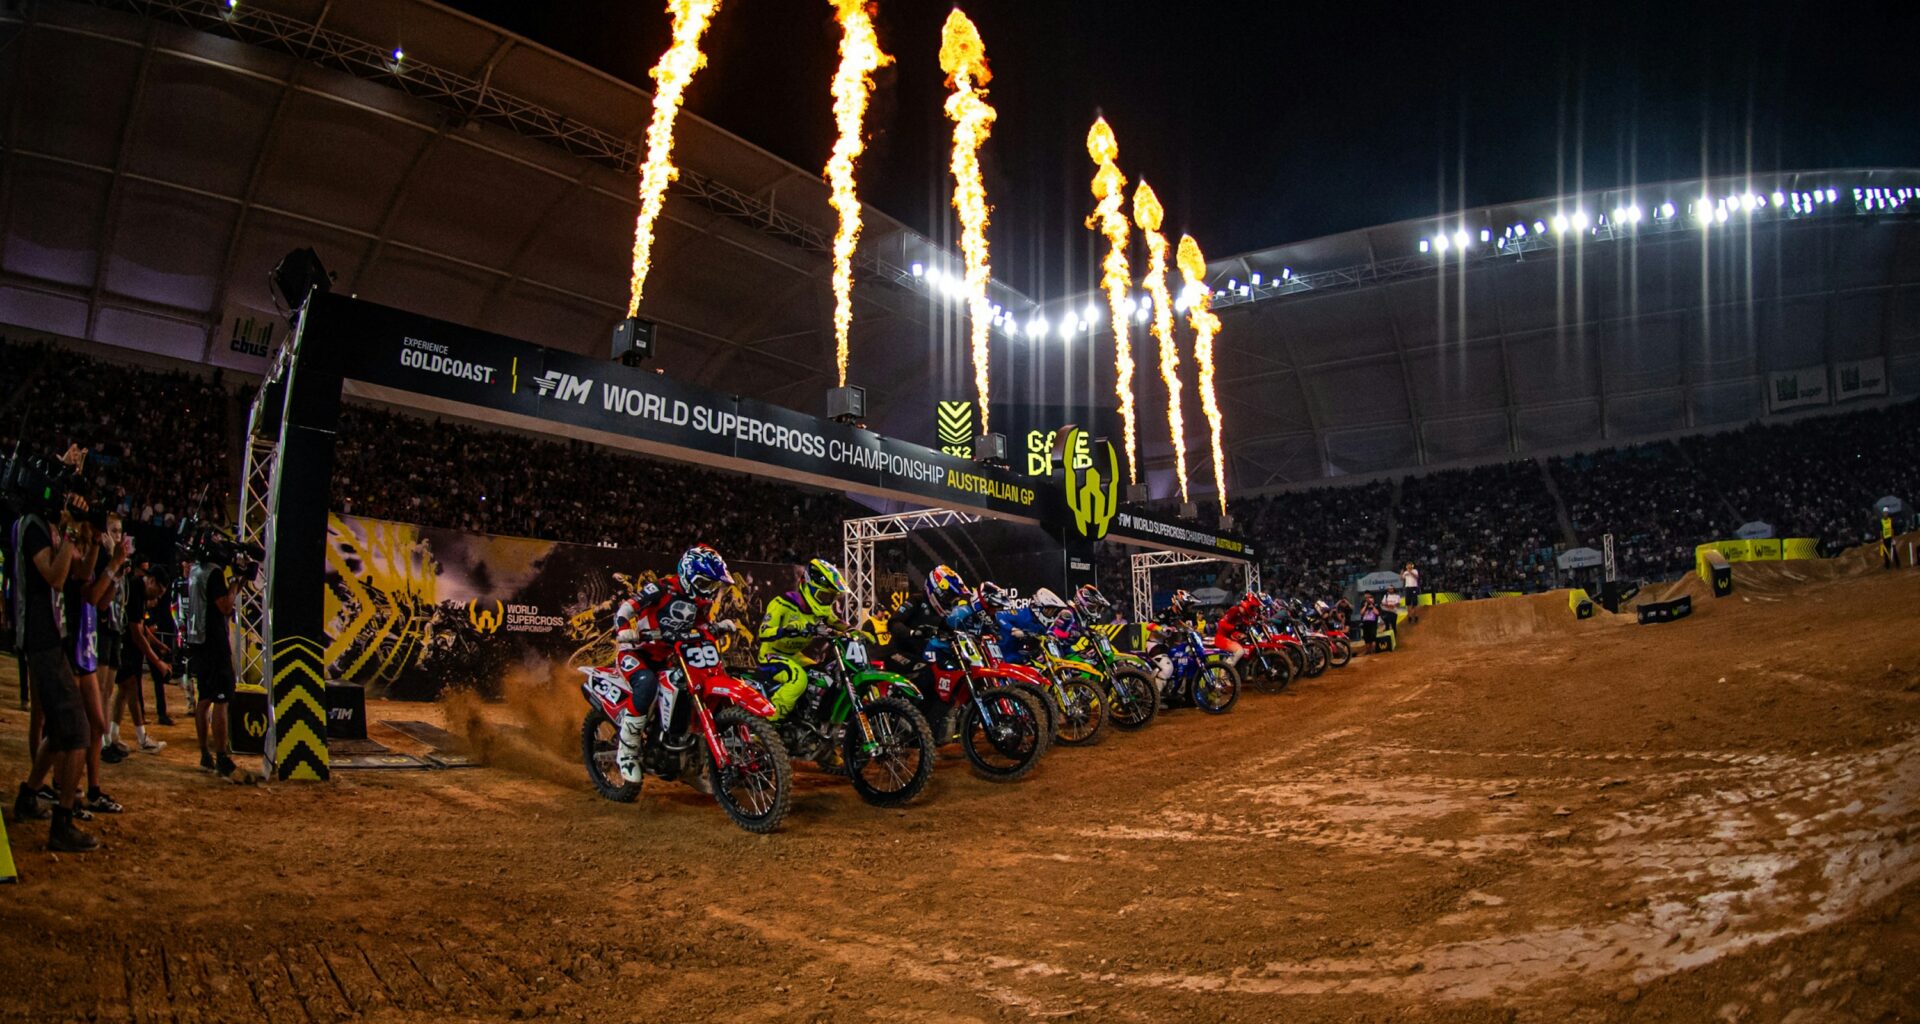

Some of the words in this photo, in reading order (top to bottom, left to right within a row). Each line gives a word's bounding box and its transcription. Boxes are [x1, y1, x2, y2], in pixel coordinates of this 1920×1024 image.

[403, 336, 449, 355] EXPERIENCE
[533, 370, 593, 404] FIM
[603, 382, 689, 426] WORLD
[692, 405, 825, 458] SUPERCROSS
[828, 439, 944, 485] CHAMPIONSHIP
[947, 469, 1018, 503] AUSTRALIAN
[1020, 489, 1035, 506] GP
[1027, 430, 1090, 454] GAE
[506, 604, 538, 615] WORLD
[506, 614, 564, 626] SUPERCROSS
[506, 625, 553, 633] CHAMPIONSHIP
[686, 645, 719, 668] 39
[594, 679, 622, 705] 39
[328, 707, 353, 720] FIM
